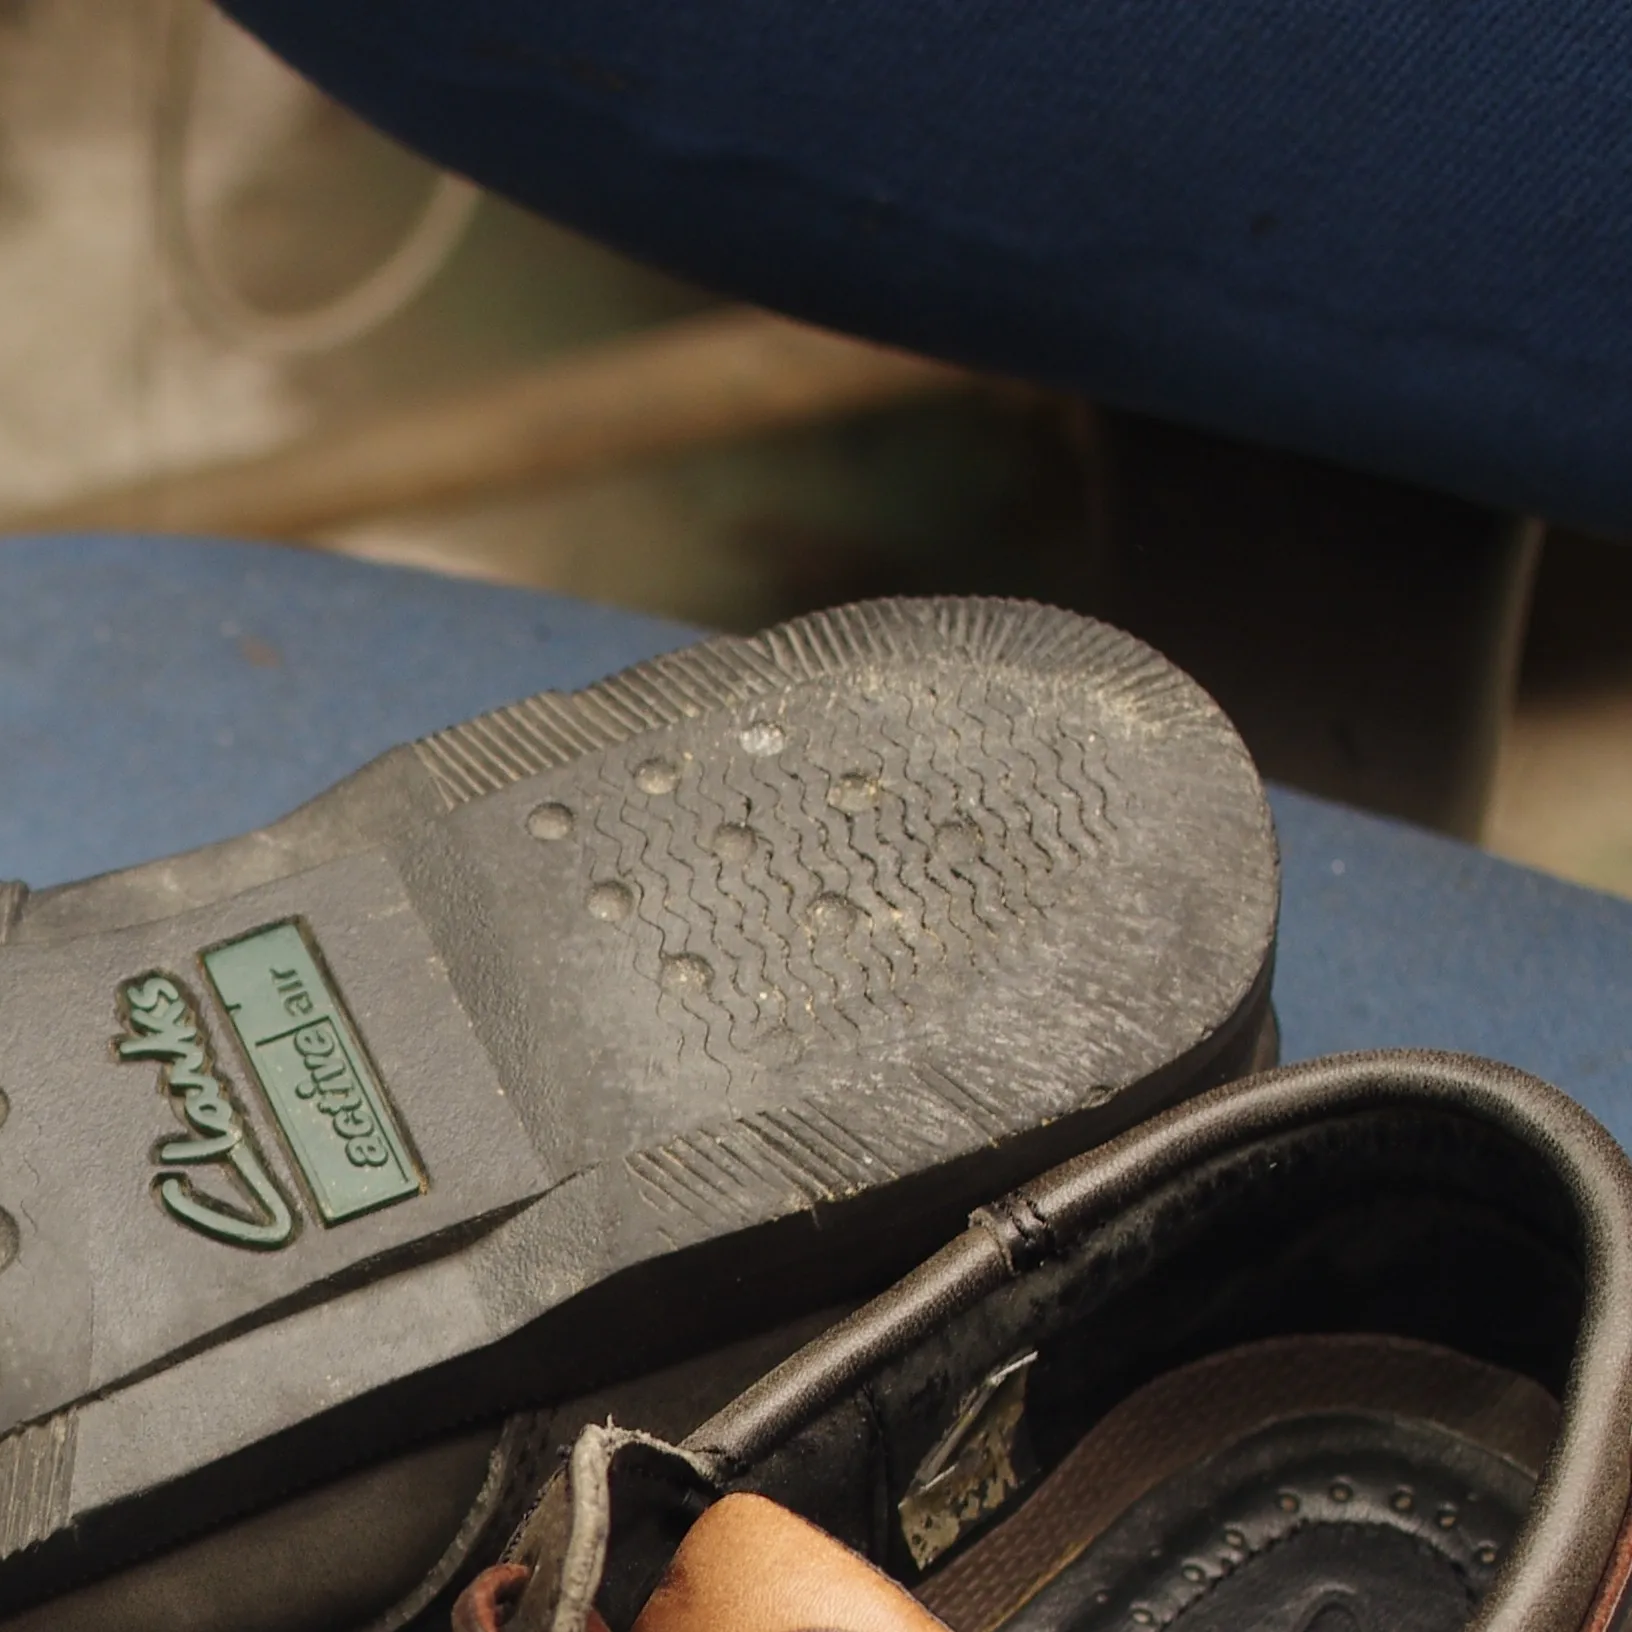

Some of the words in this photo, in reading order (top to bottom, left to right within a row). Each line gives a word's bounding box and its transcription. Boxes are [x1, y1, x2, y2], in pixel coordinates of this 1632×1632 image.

[268, 966, 315, 1018] air
[118, 973, 295, 1251] Clarks
[293, 1026, 390, 1169] active
